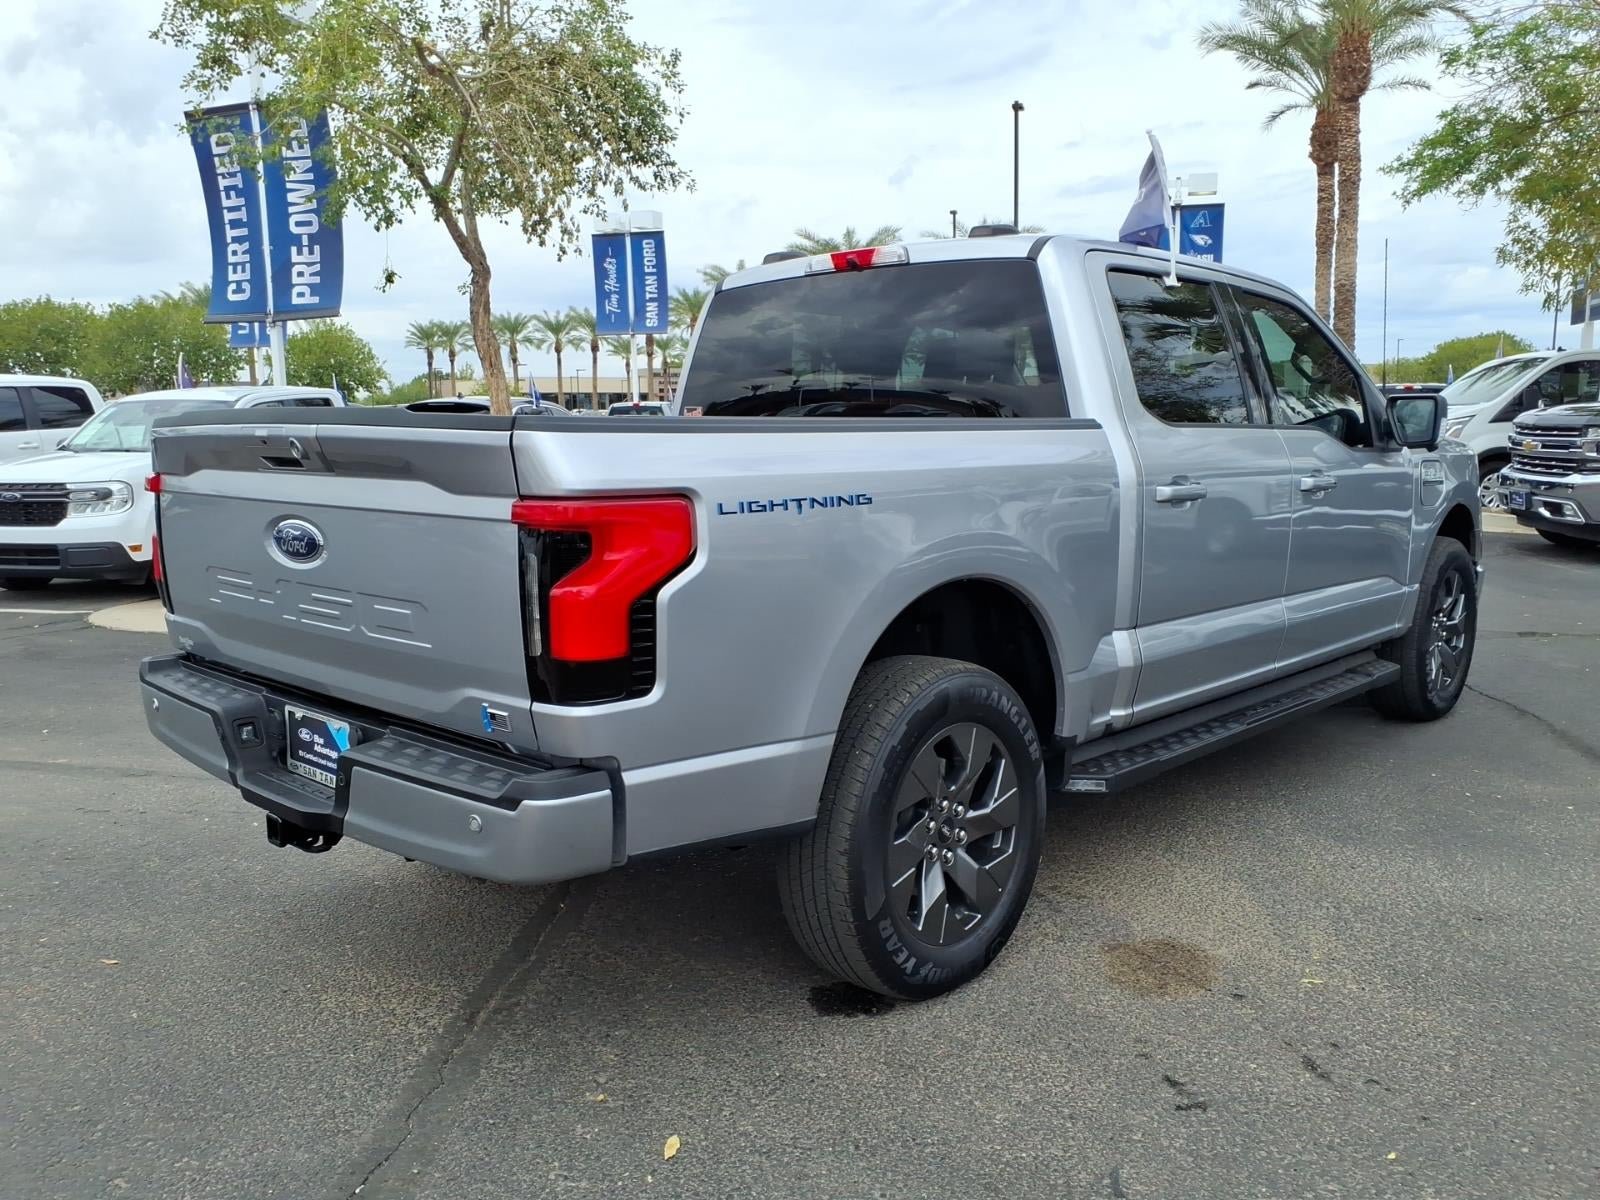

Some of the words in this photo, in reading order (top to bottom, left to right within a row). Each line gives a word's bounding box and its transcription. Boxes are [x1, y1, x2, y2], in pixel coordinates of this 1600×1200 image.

[210, 131, 251, 301] CERTIFIED
[642, 239, 657, 273] FORD
[644, 276, 658, 301] TAN
[605, 292, 621, 314] Tim
[646, 302, 658, 327] SAN
[717, 494, 872, 515] LIGHTNING
[963, 685, 1040, 761] RANGLER
[303, 765, 317, 779] SAN
